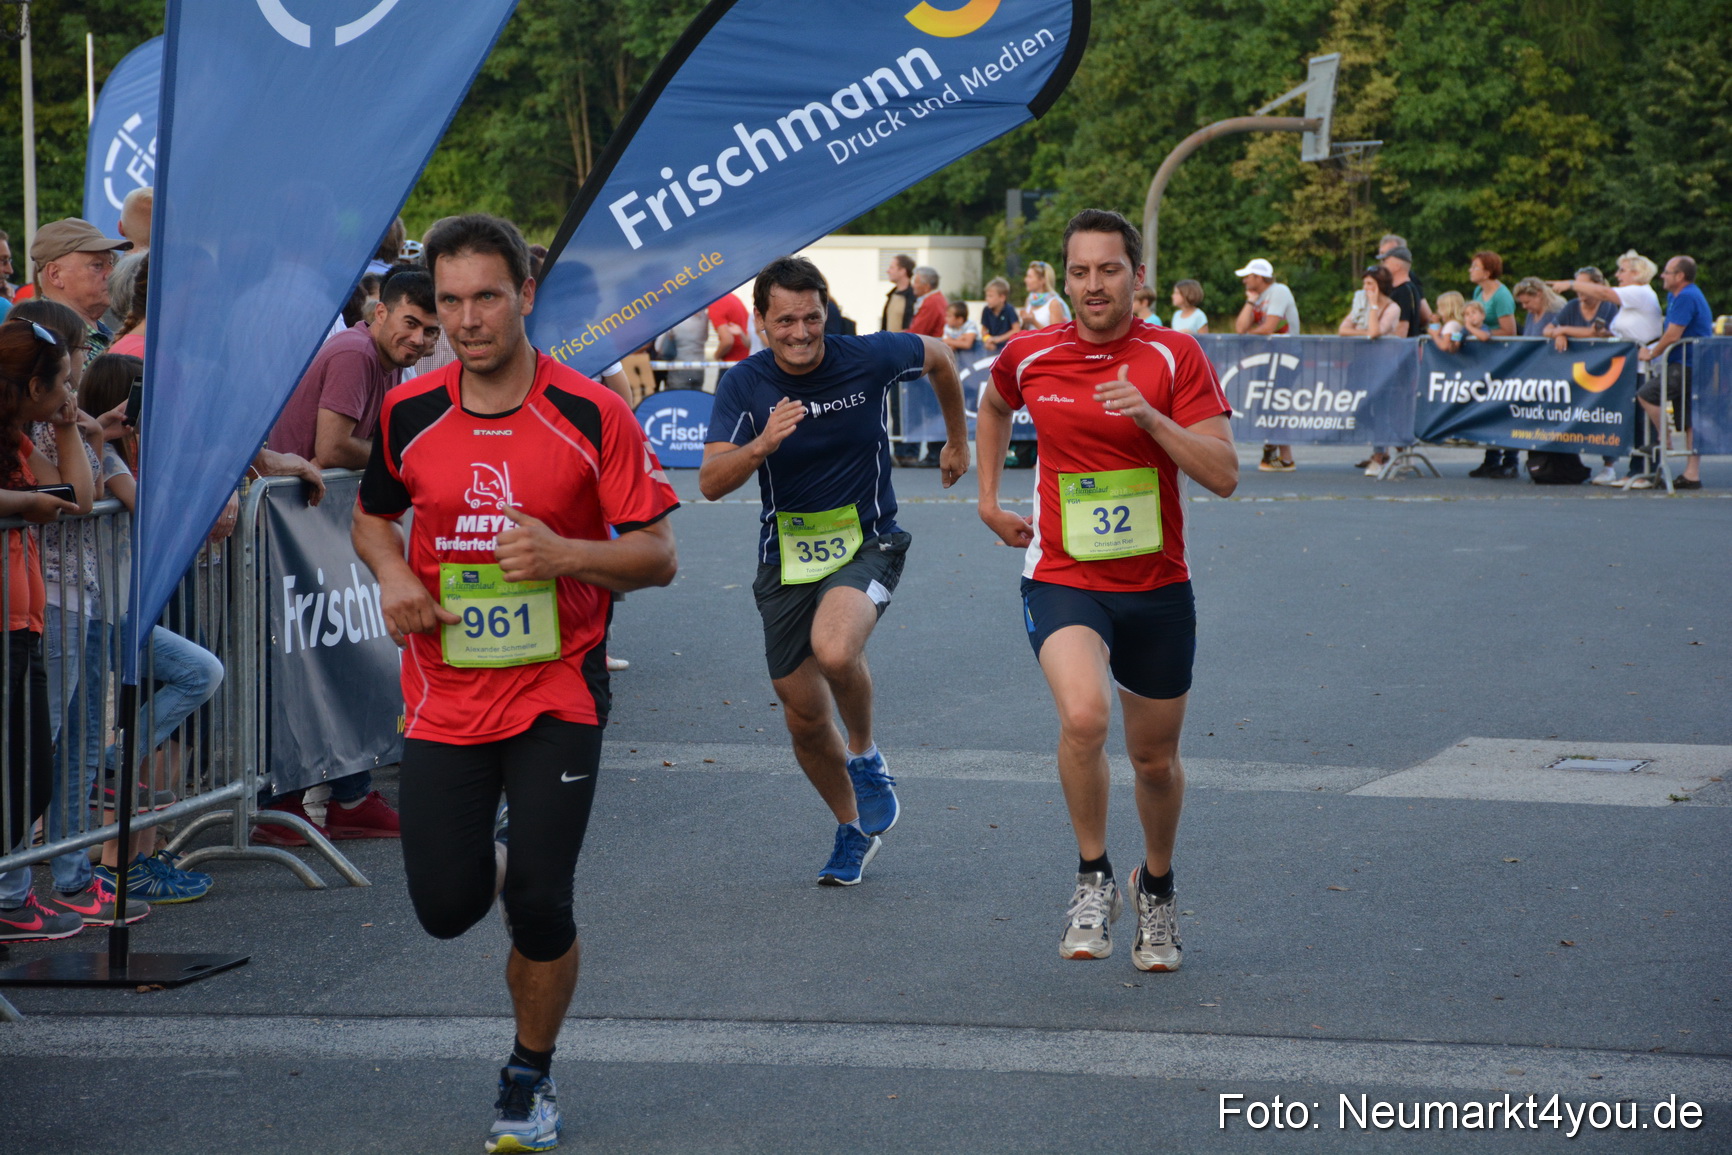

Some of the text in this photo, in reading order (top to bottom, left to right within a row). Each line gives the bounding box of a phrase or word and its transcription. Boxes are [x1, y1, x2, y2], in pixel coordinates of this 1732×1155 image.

[826, 28, 1055, 165] Druck und Medien
[608, 47, 942, 250] Frischmann
[549, 251, 725, 364] frischmann-net.de
[823, 391, 866, 413] POLES
[1244, 381, 1368, 413] Fischer
[1428, 371, 1572, 403] Frischmann
[1255, 415, 1357, 430] AUTOMOBILE
[1510, 404, 1623, 425] Druck und Medien
[1511, 428, 1621, 446] www.frischmann-net.de
[455, 515, 521, 533] MEYE
[1092, 505, 1132, 536] 32
[796, 537, 848, 563] 353
[463, 602, 531, 639] 961
